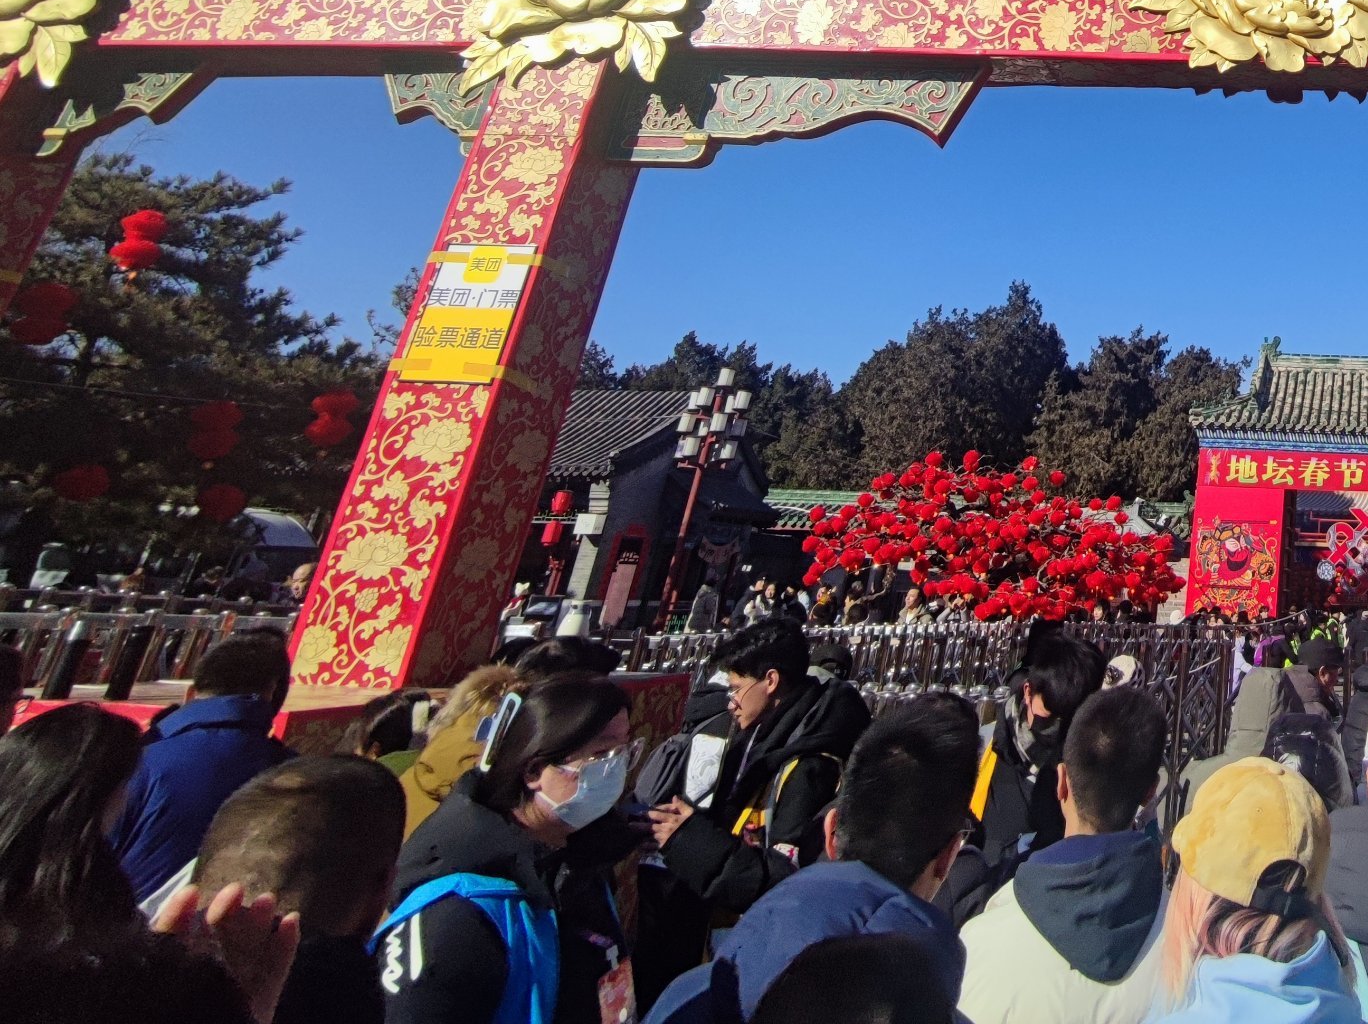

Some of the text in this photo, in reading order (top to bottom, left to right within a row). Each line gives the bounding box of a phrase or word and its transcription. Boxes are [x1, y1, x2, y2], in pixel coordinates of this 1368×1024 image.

[468, 257, 502, 272] 美团
[413, 326, 505, 350] 验票通道
